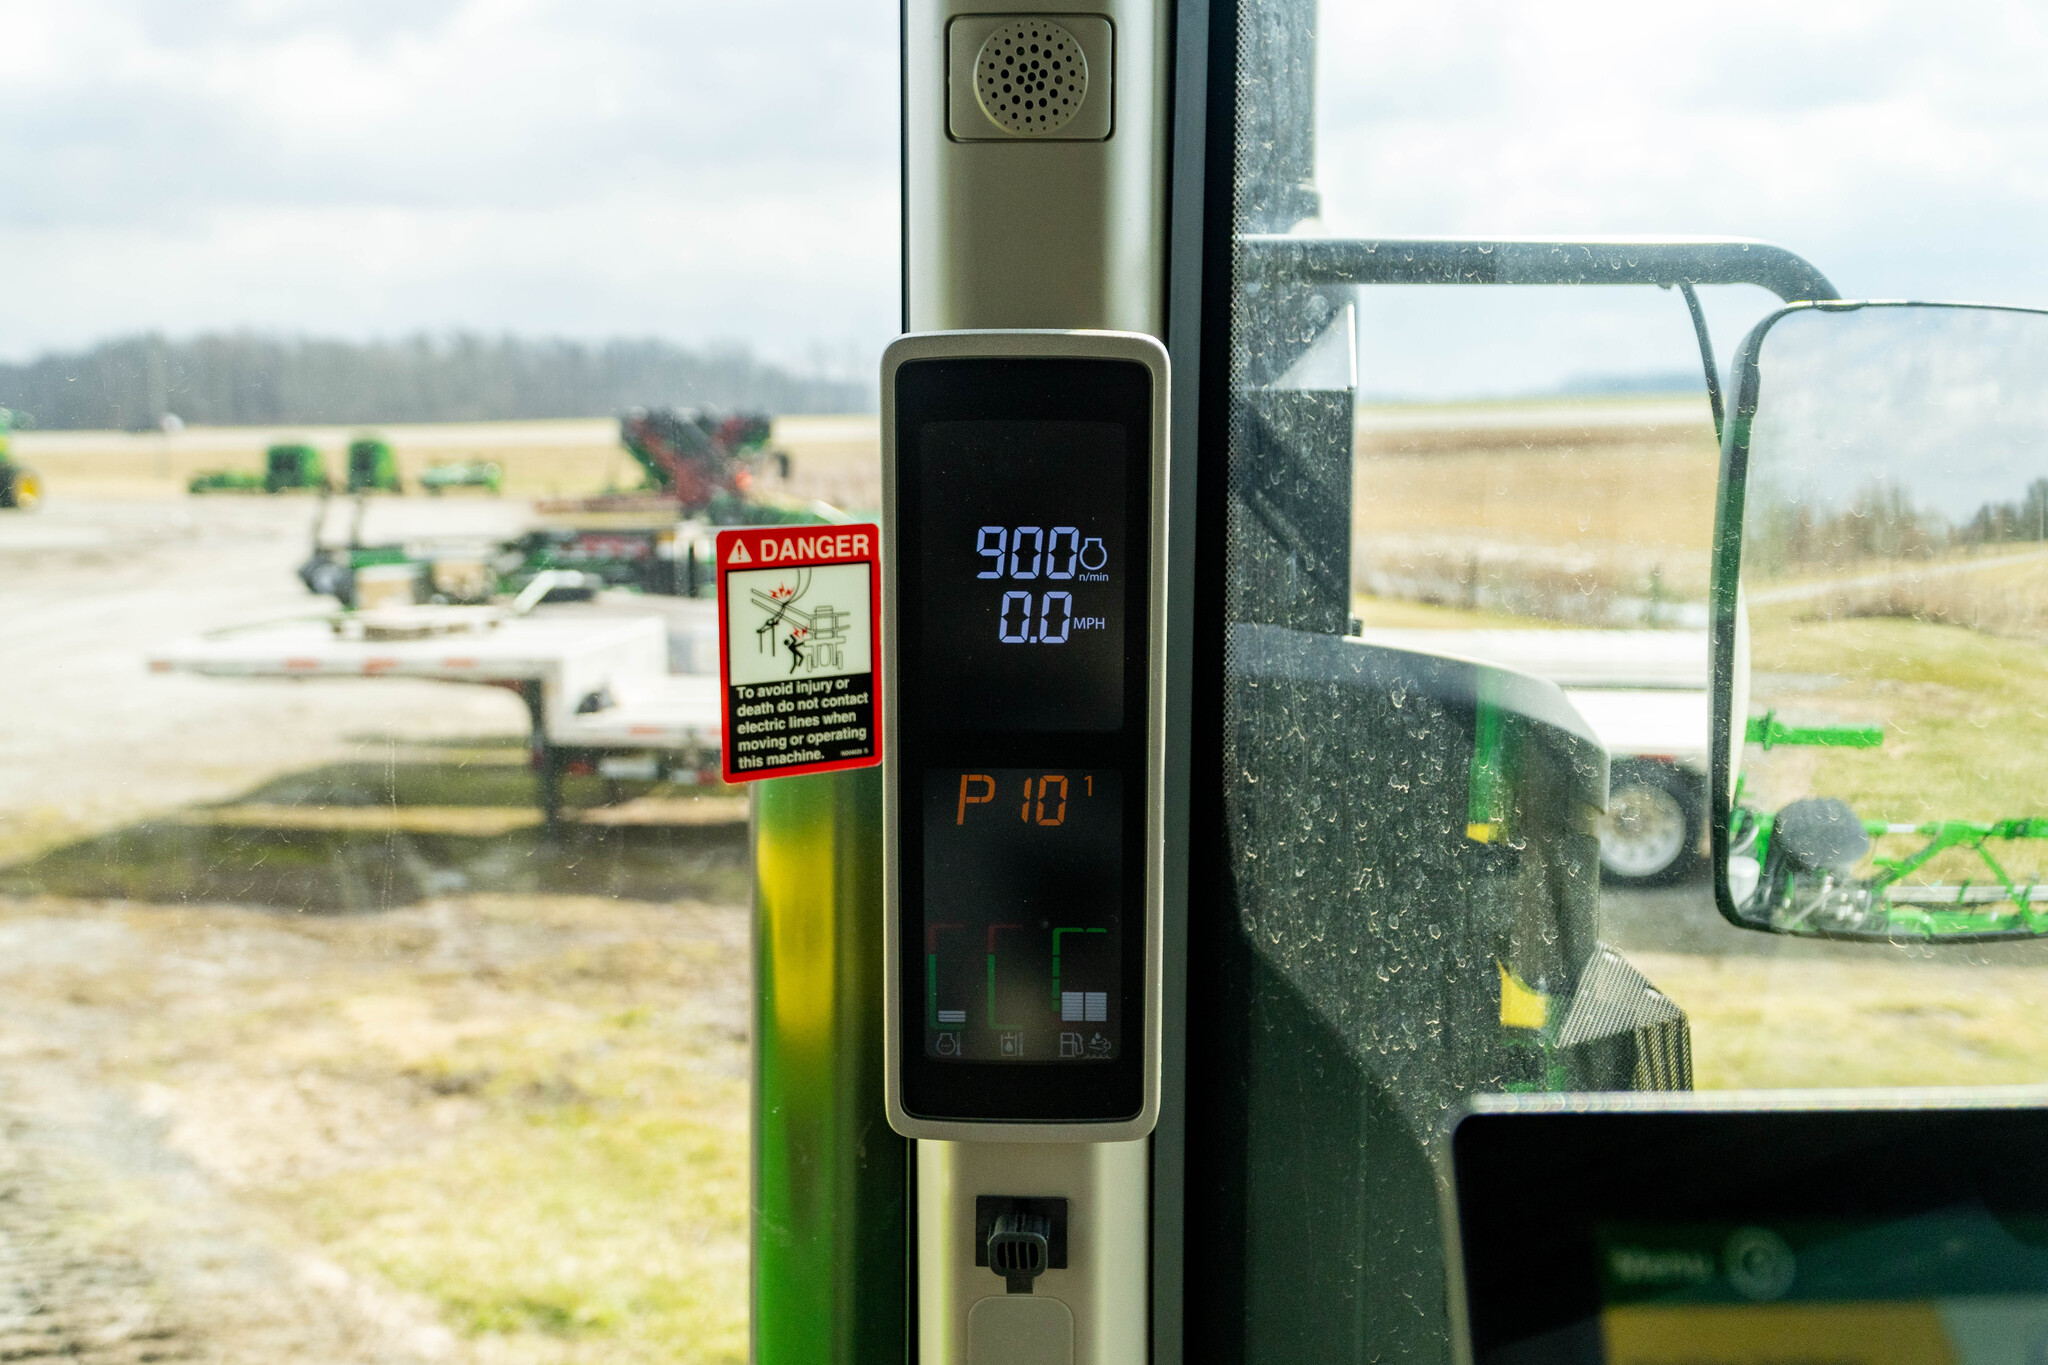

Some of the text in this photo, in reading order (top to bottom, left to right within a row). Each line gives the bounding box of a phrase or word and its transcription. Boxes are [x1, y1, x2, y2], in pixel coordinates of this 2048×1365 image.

[760, 534, 869, 562] DANGER
[976, 526, 1080, 579] 900
[1079, 572, 1109, 582] n/min
[1000, 591, 1073, 643] 0.0
[1073, 618, 1105, 630] MPH
[736, 679, 850, 699] To avoid injury or
[736, 692, 868, 717] death do not contact
[737, 711, 856, 734] electric lines when
[738, 727, 866, 752] moving or operating
[738, 755, 764, 769] this
[766, 750, 824, 766] machine.
[1084, 775, 1092, 796] 1
[957, 774, 1068, 826] P 10
